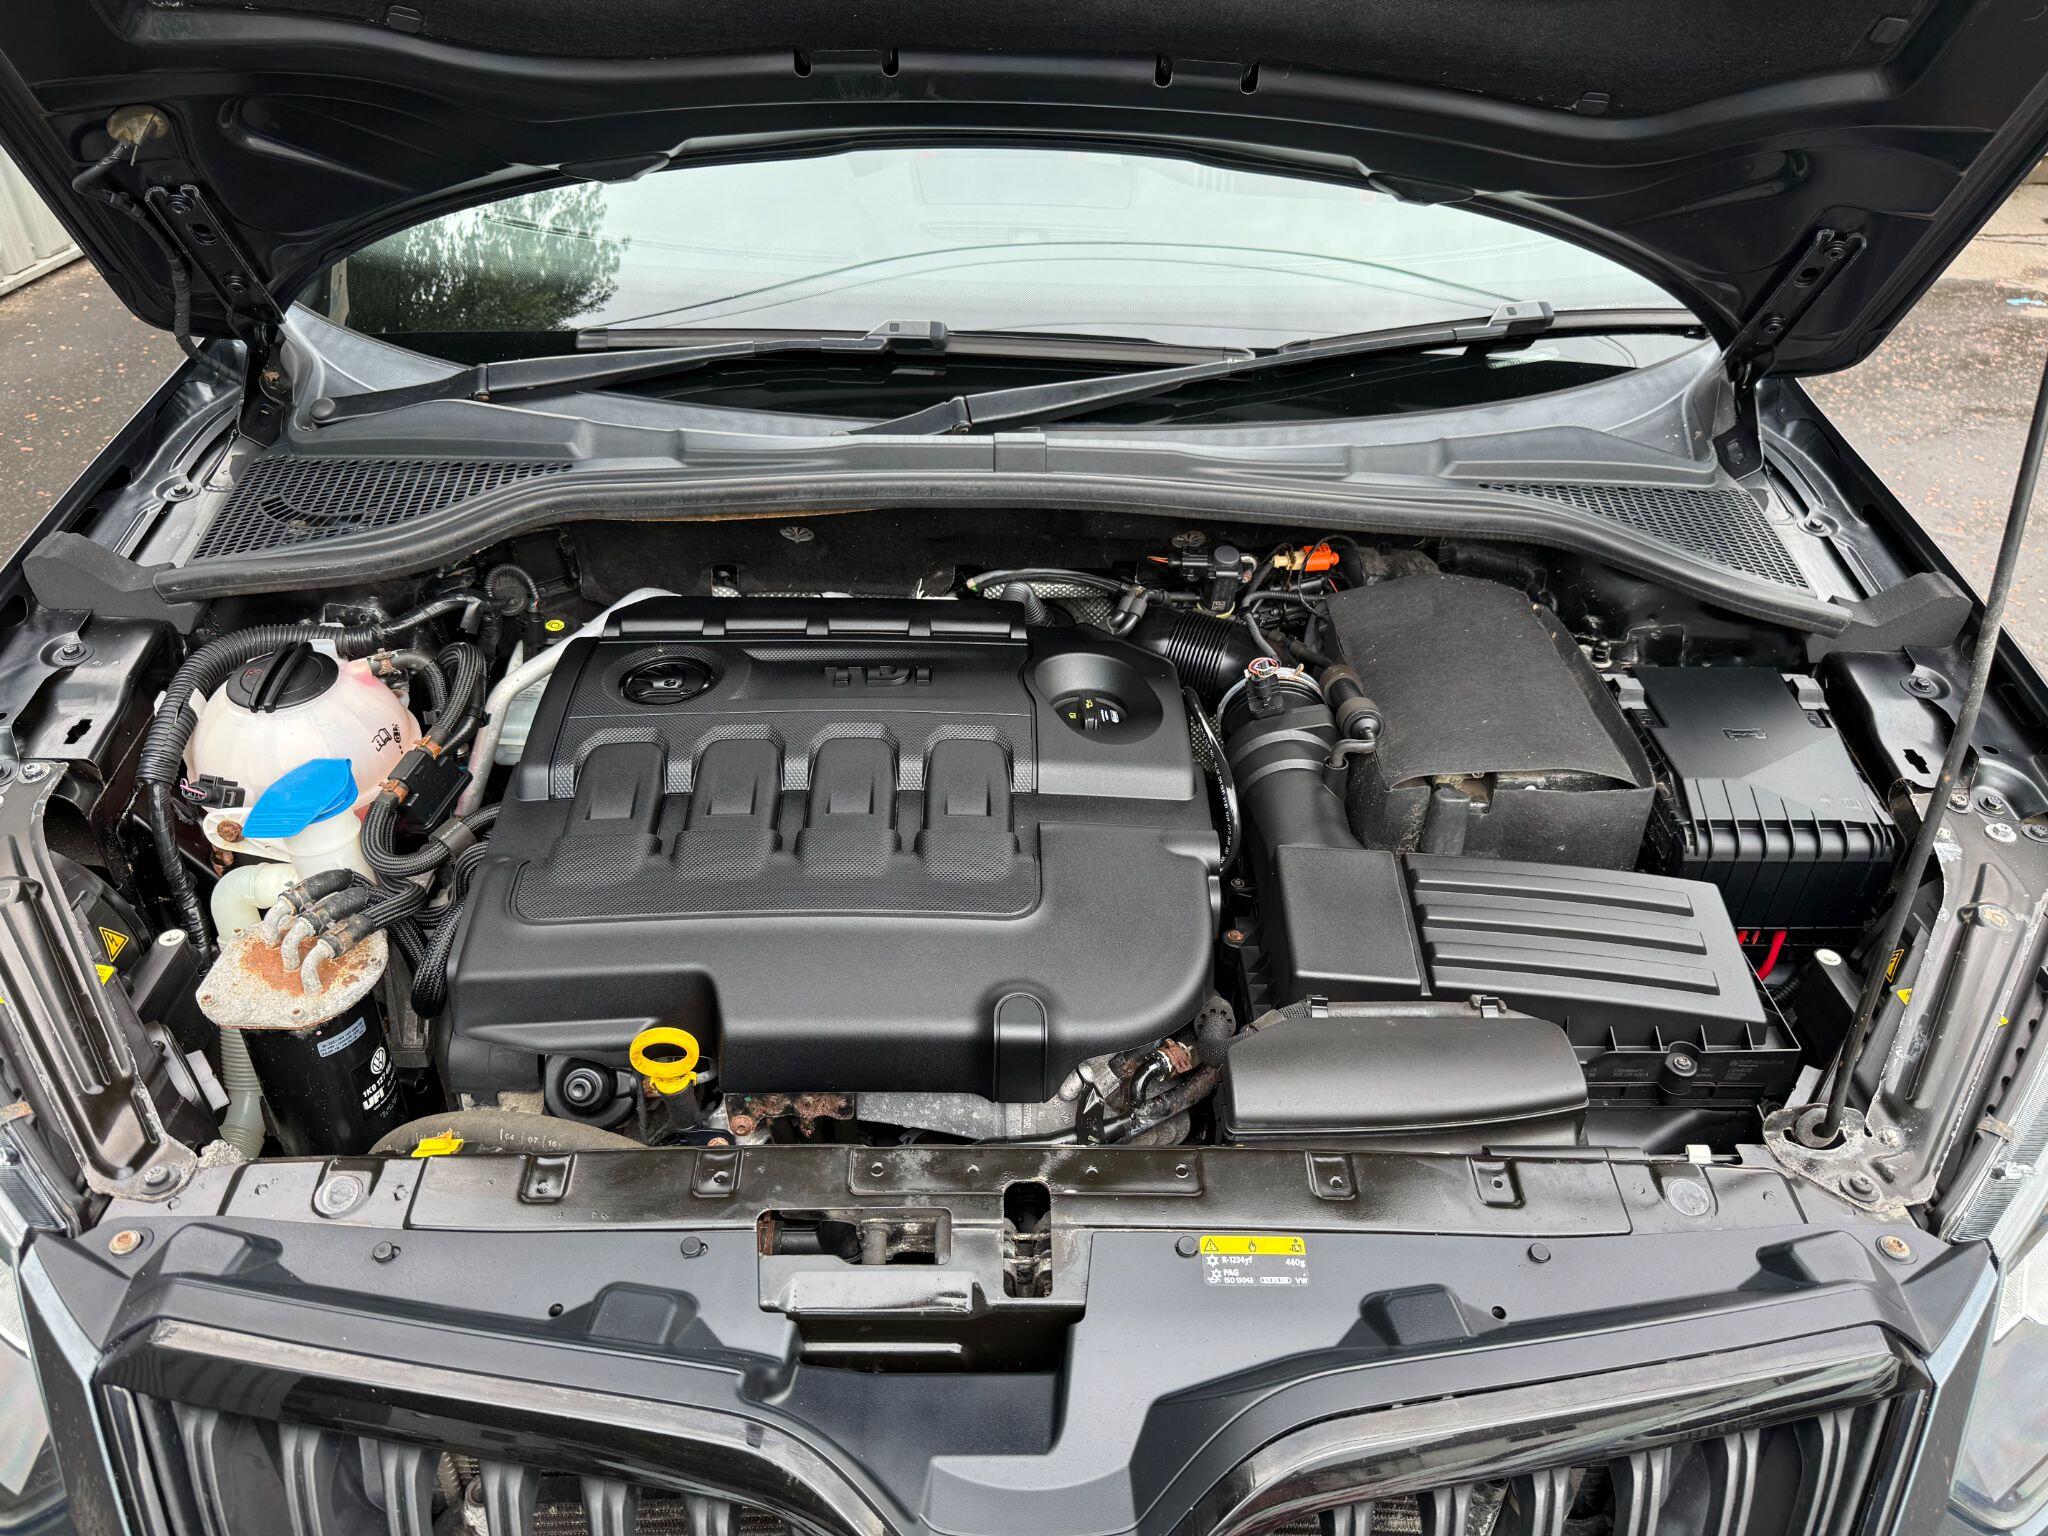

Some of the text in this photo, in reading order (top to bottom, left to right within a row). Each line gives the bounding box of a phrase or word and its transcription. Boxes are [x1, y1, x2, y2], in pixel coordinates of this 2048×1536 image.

[362, 1086, 385, 1110] UFI
[1285, 1258, 1306, 1268] 460g
[1223, 1268, 1240, 1277] PAG
